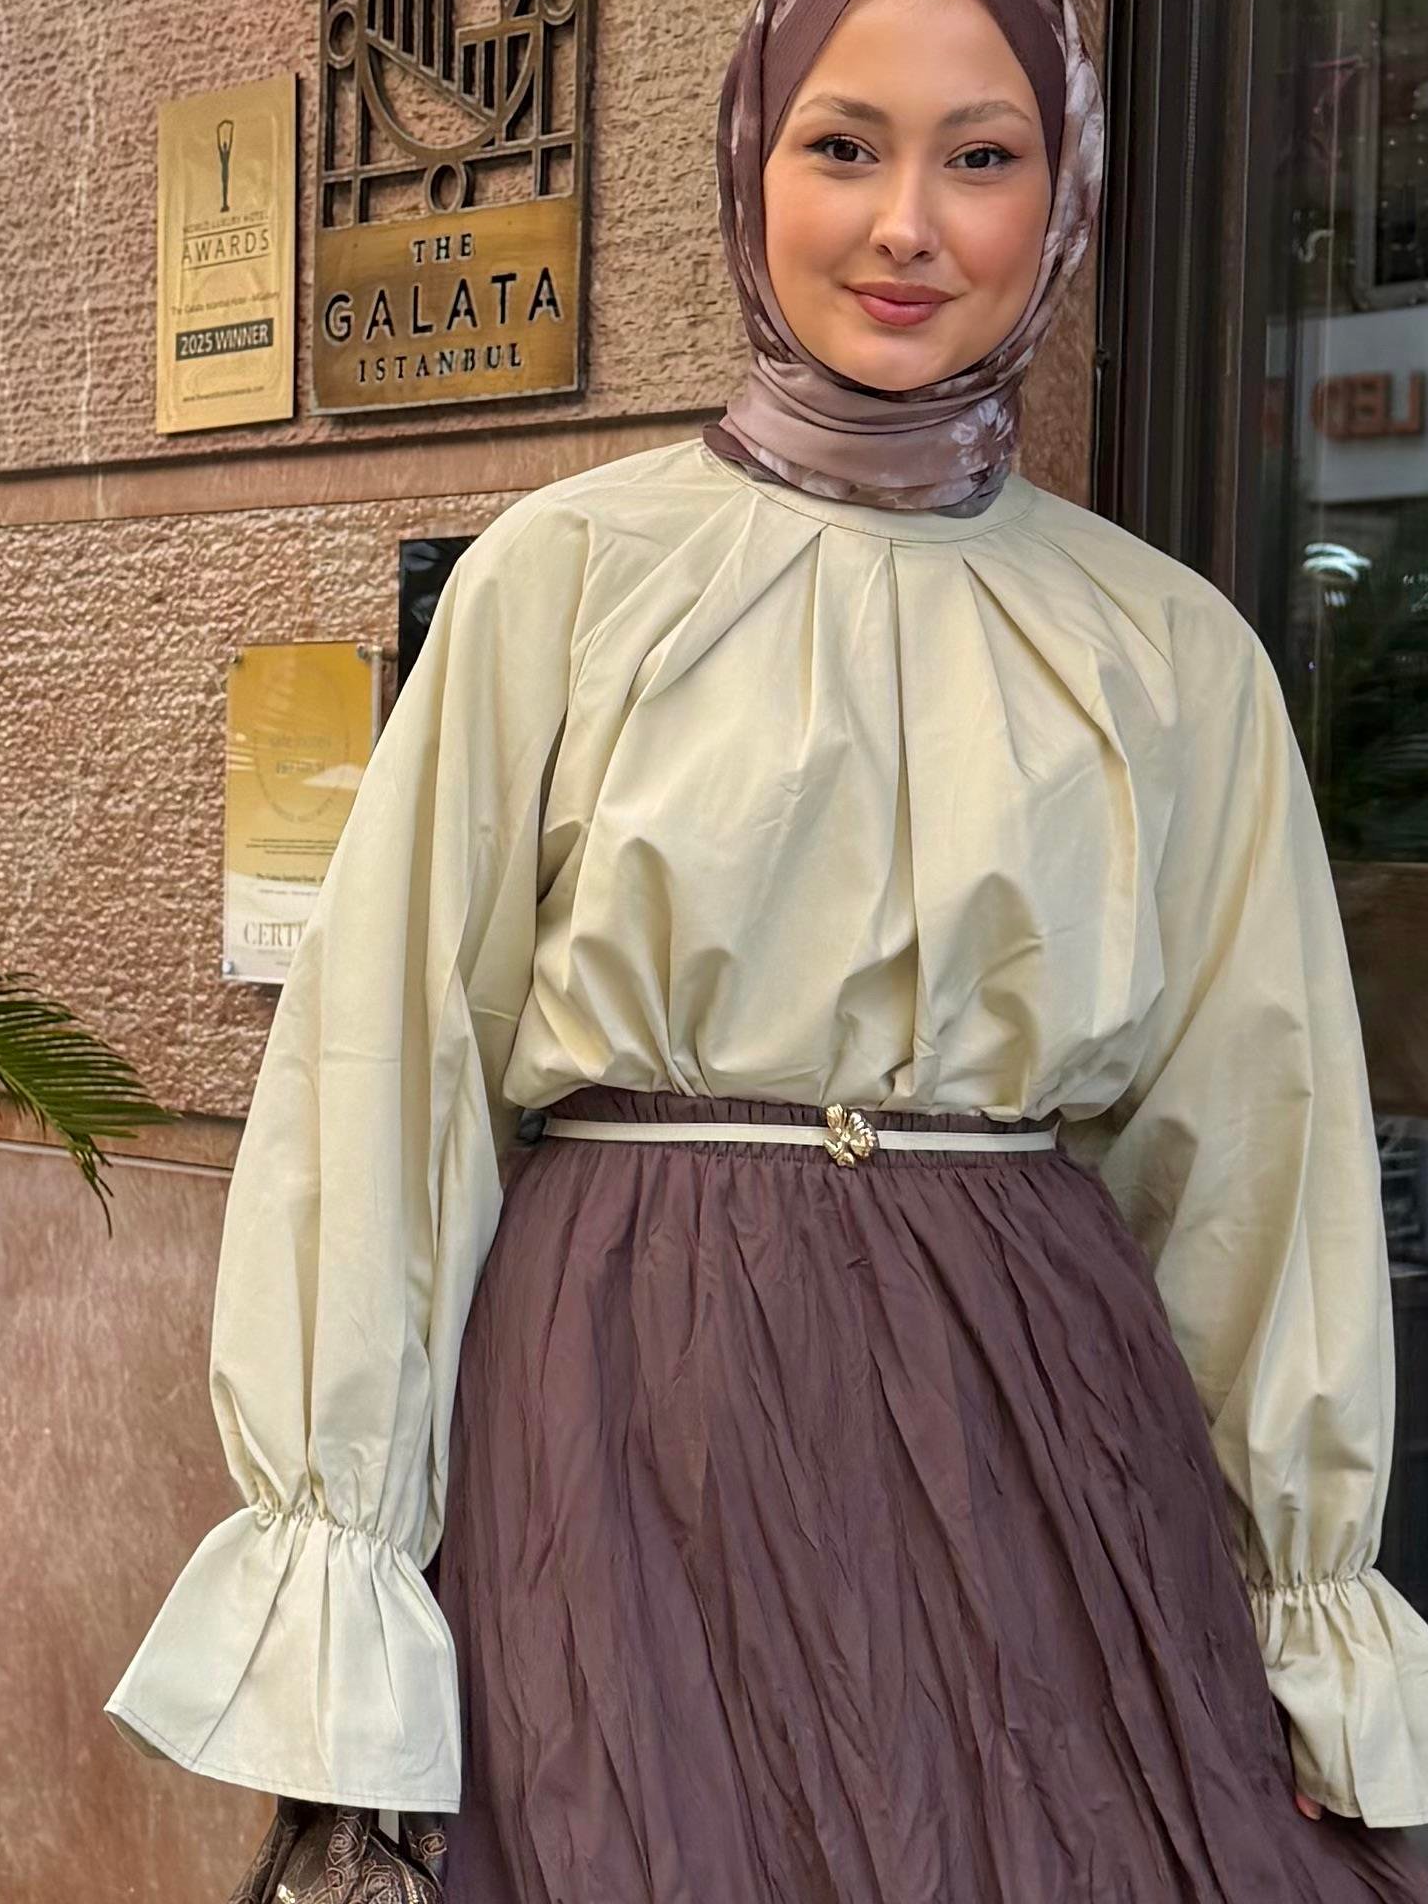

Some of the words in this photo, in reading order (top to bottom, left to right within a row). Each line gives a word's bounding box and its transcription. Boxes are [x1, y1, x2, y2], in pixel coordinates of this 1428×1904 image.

[180, 227, 271, 267] AWARDS
[412, 232, 475, 265] THE
[323, 266, 562, 343] GALATA
[179, 332, 214, 357] 2025
[214, 323, 270, 352] WINNER
[358, 342, 523, 384] ISTANBUL
[243, 919, 308, 947] CERTI
